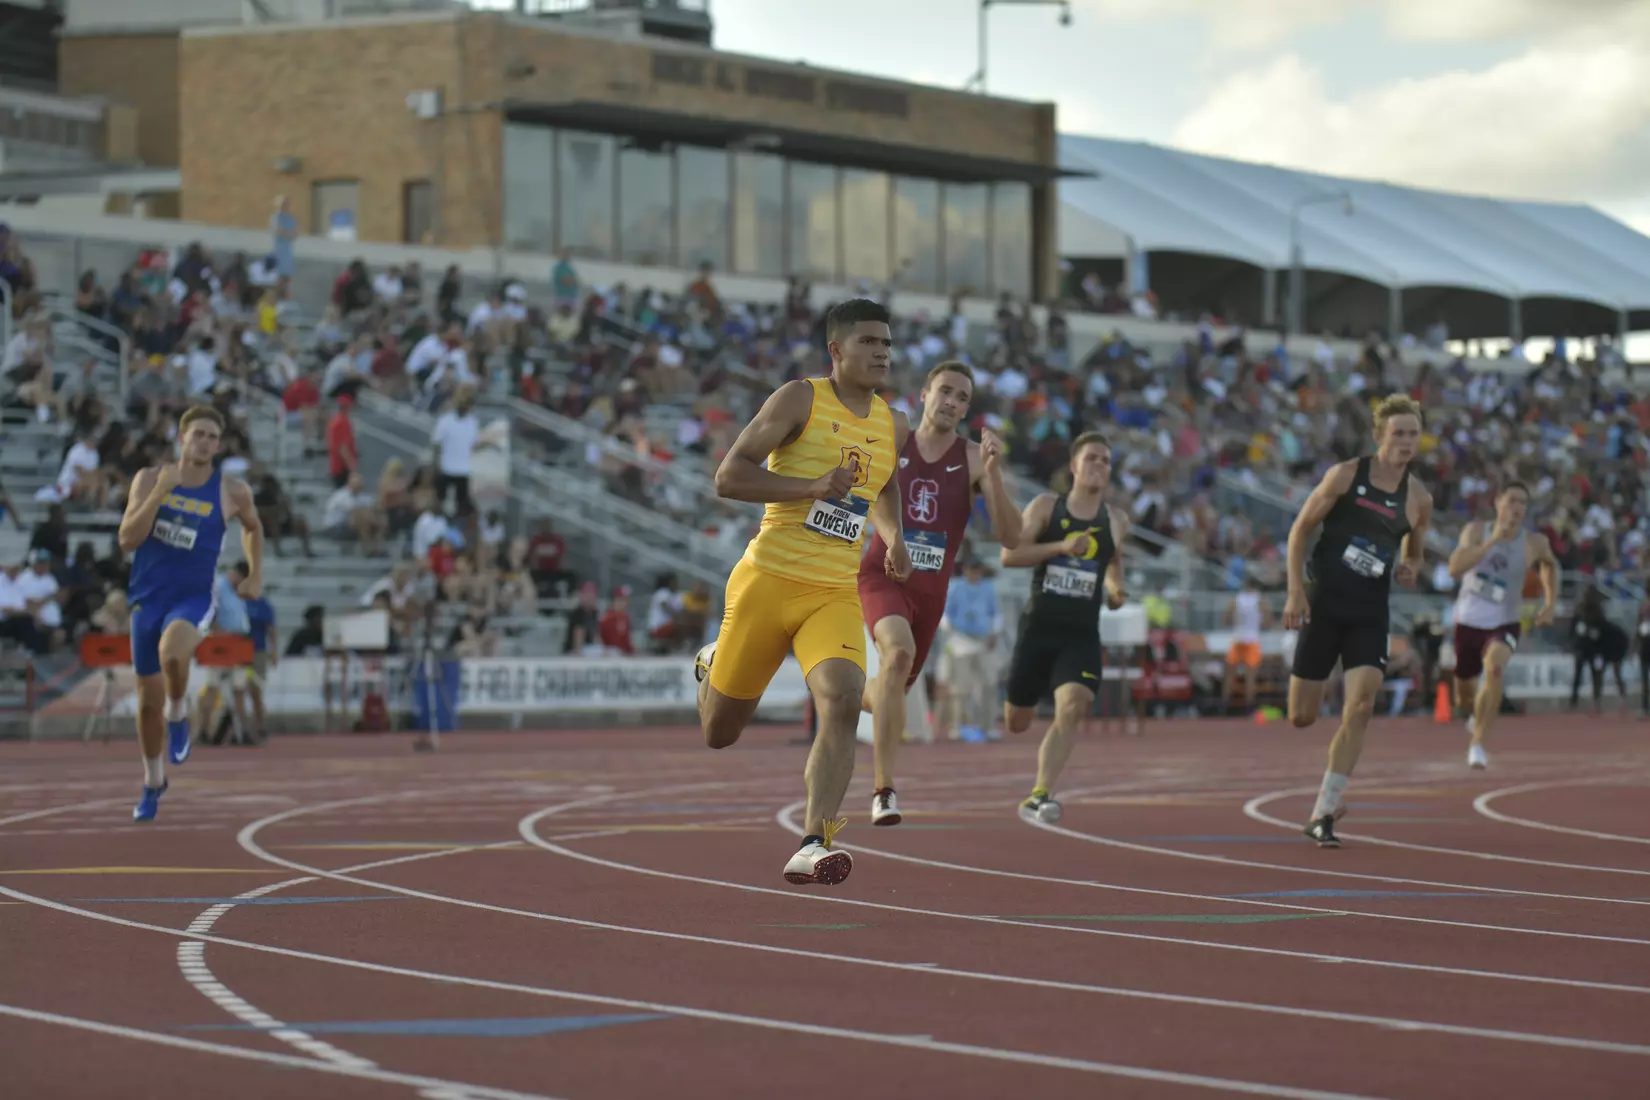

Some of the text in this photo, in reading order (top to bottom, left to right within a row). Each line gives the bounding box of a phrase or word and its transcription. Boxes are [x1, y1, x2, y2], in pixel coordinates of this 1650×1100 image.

[832, 507, 851, 520] AYDEN
[812, 510, 859, 539] OWENS
[909, 549, 943, 568] LIAMS
